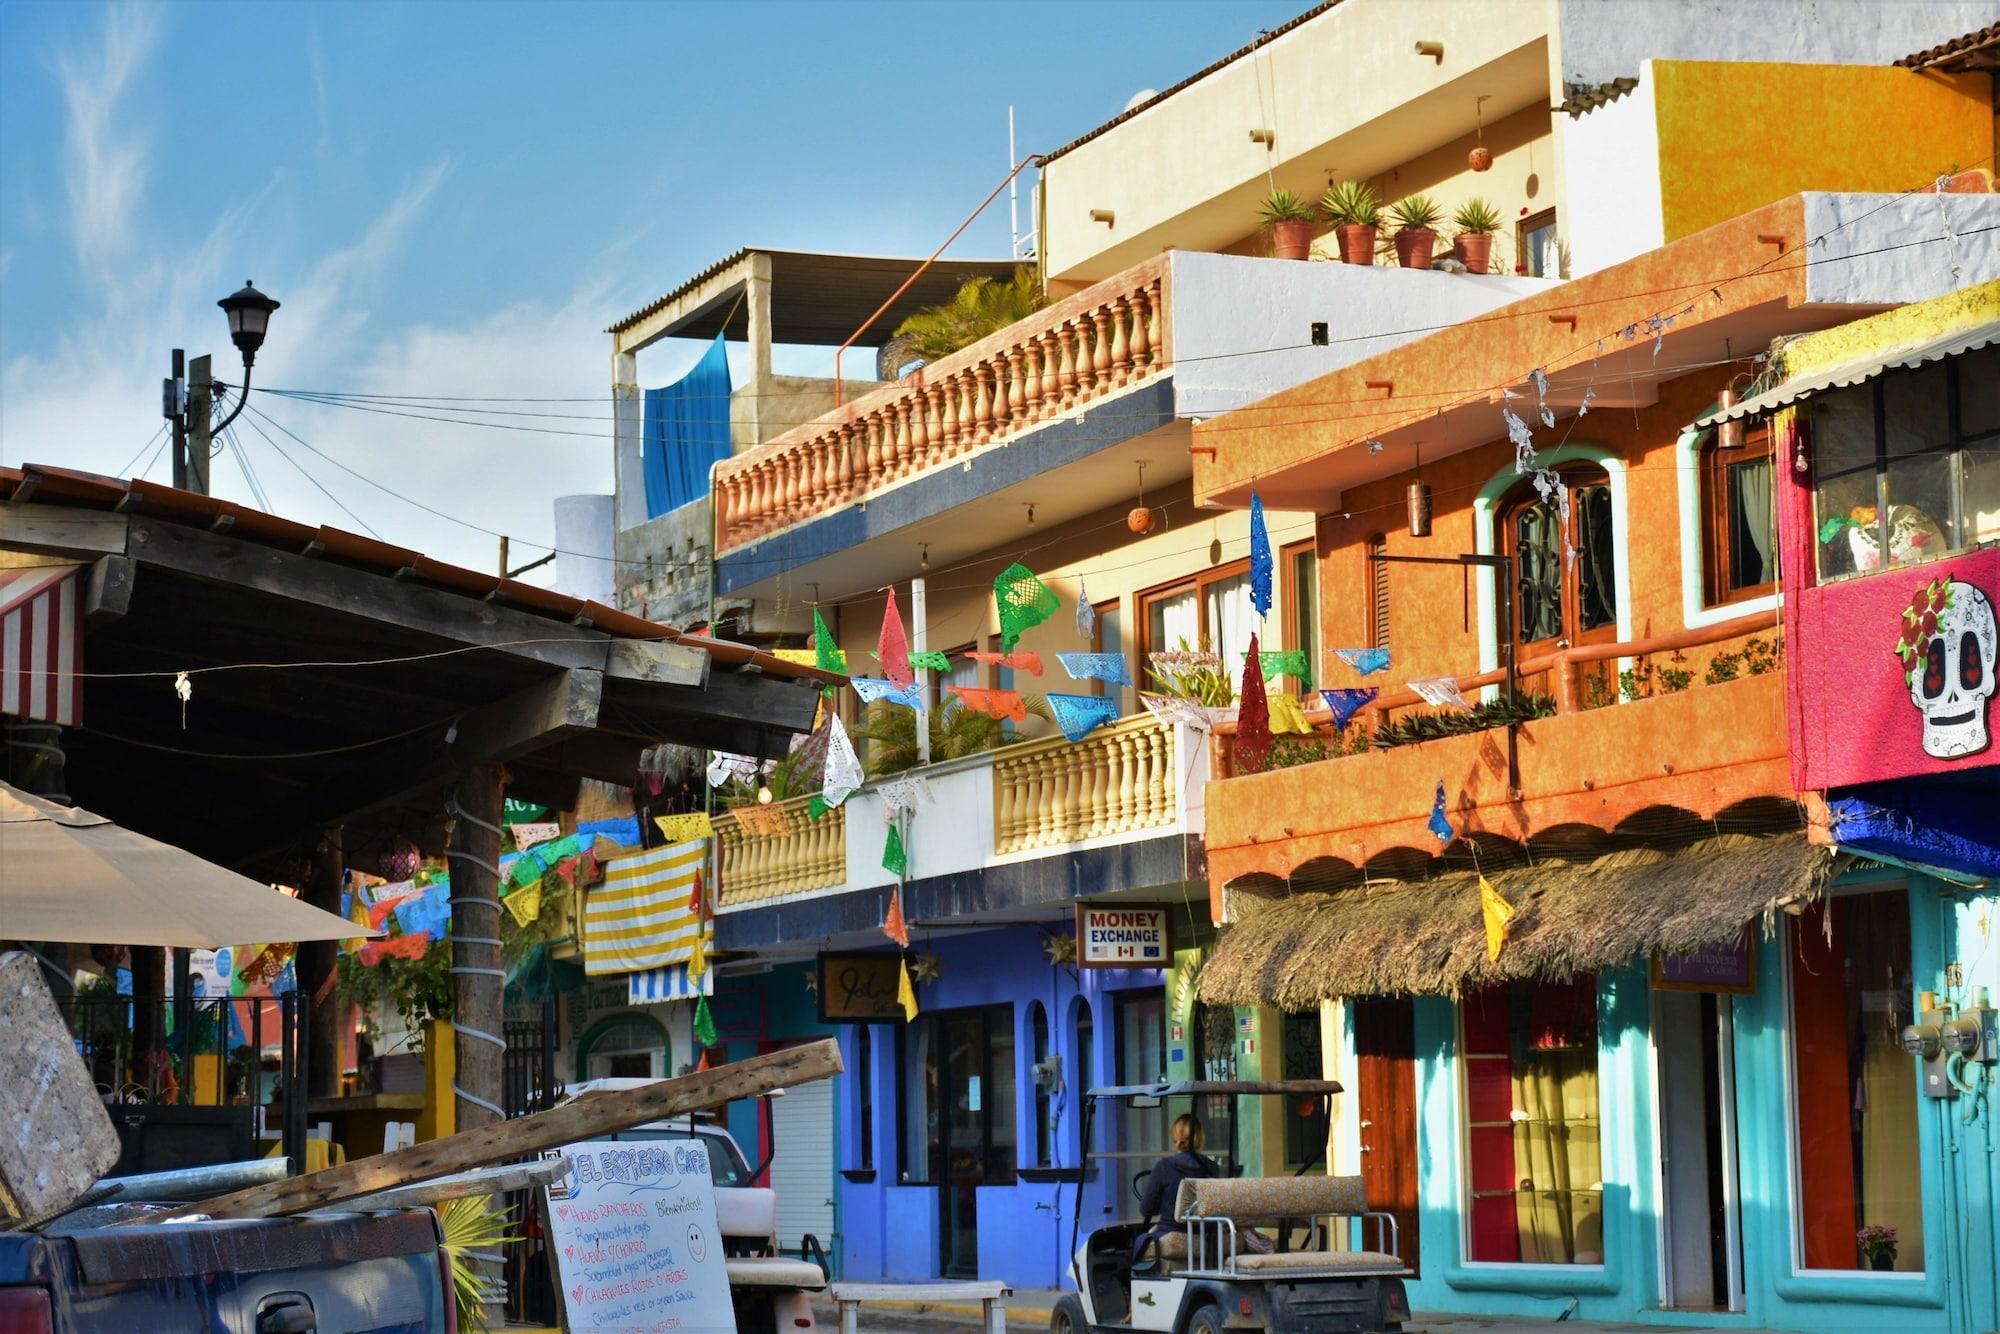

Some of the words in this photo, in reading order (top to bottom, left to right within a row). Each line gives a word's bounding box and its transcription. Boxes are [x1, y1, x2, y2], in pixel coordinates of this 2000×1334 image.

[1090, 912, 1159, 928] MONEY
[1091, 929, 1159, 943] EXCHANGE
[633, 1221, 651, 1240] eggs
